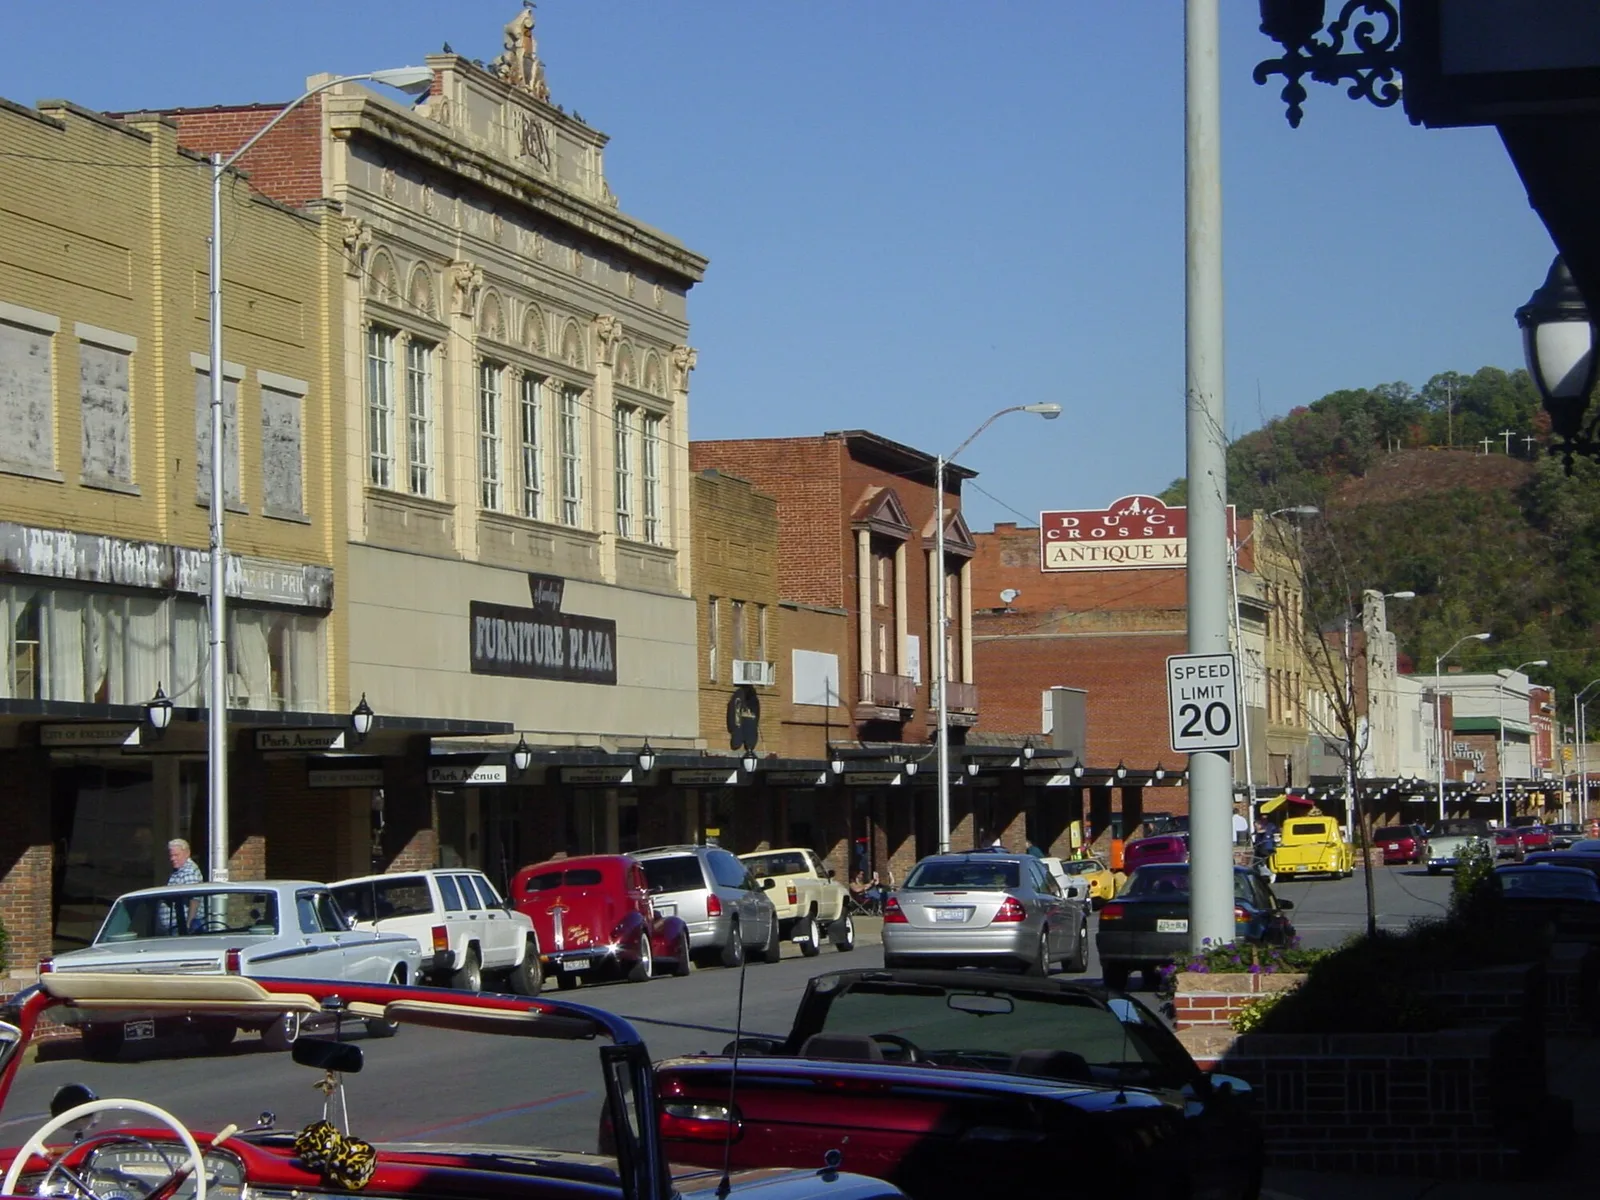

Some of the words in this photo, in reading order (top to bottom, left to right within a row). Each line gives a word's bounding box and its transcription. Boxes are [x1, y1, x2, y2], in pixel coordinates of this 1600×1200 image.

[1061, 514, 1166, 528] DUC
[1047, 525, 1177, 539] CROSSI
[1053, 545, 1154, 562] ANTIQUE
[475, 616, 564, 666] FURNITURE
[569, 628, 613, 671] PLAZA
[1174, 664, 1230, 680] SPEED
[1181, 685, 1225, 700] LIMIT
[1179, 701, 1231, 737] 20
[261, 733, 290, 747] Park
[293, 733, 337, 747] Avenue
[432, 768, 458, 781] Park
[461, 768, 501, 781] Avenue
